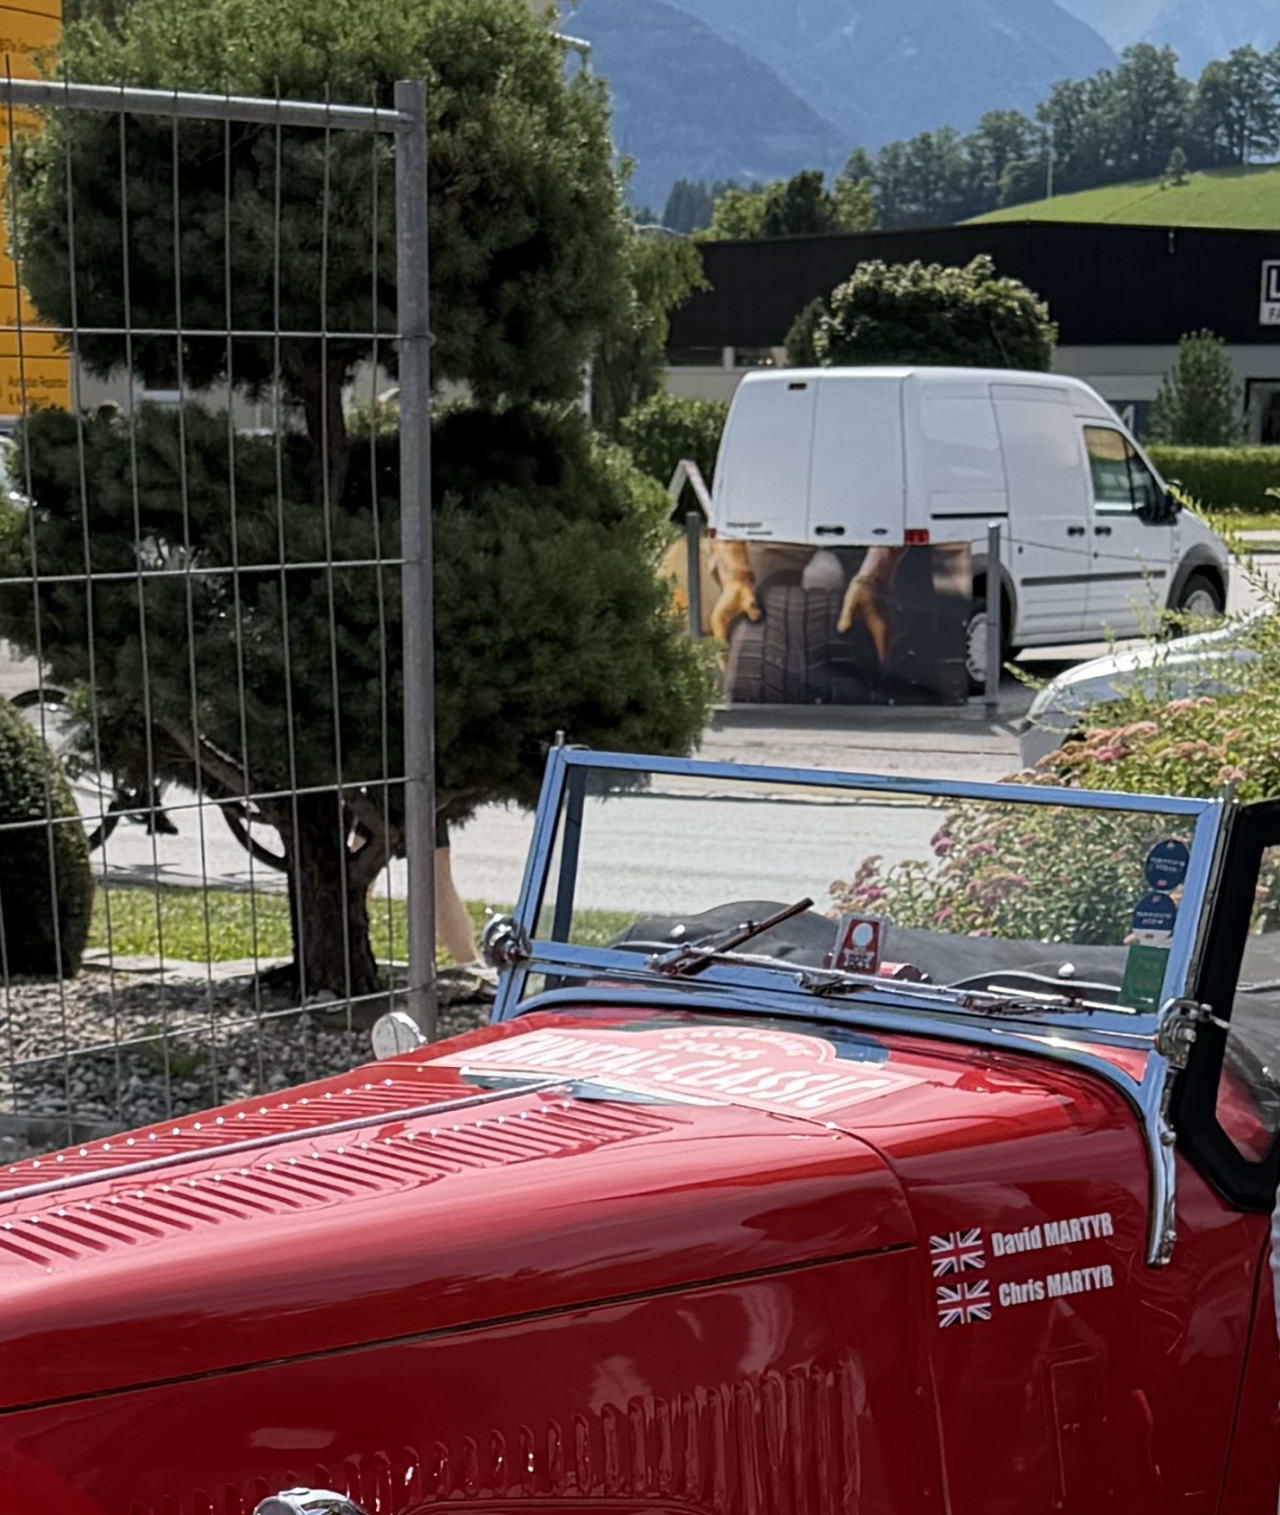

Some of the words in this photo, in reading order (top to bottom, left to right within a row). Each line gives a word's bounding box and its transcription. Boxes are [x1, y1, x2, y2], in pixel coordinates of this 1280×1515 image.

[991, 1225, 1041, 1257] David
[1044, 1212, 1115, 1247] MARTYR
[998, 1278, 1045, 1307] Chris
[1047, 1264, 1114, 1298] MARTYR
